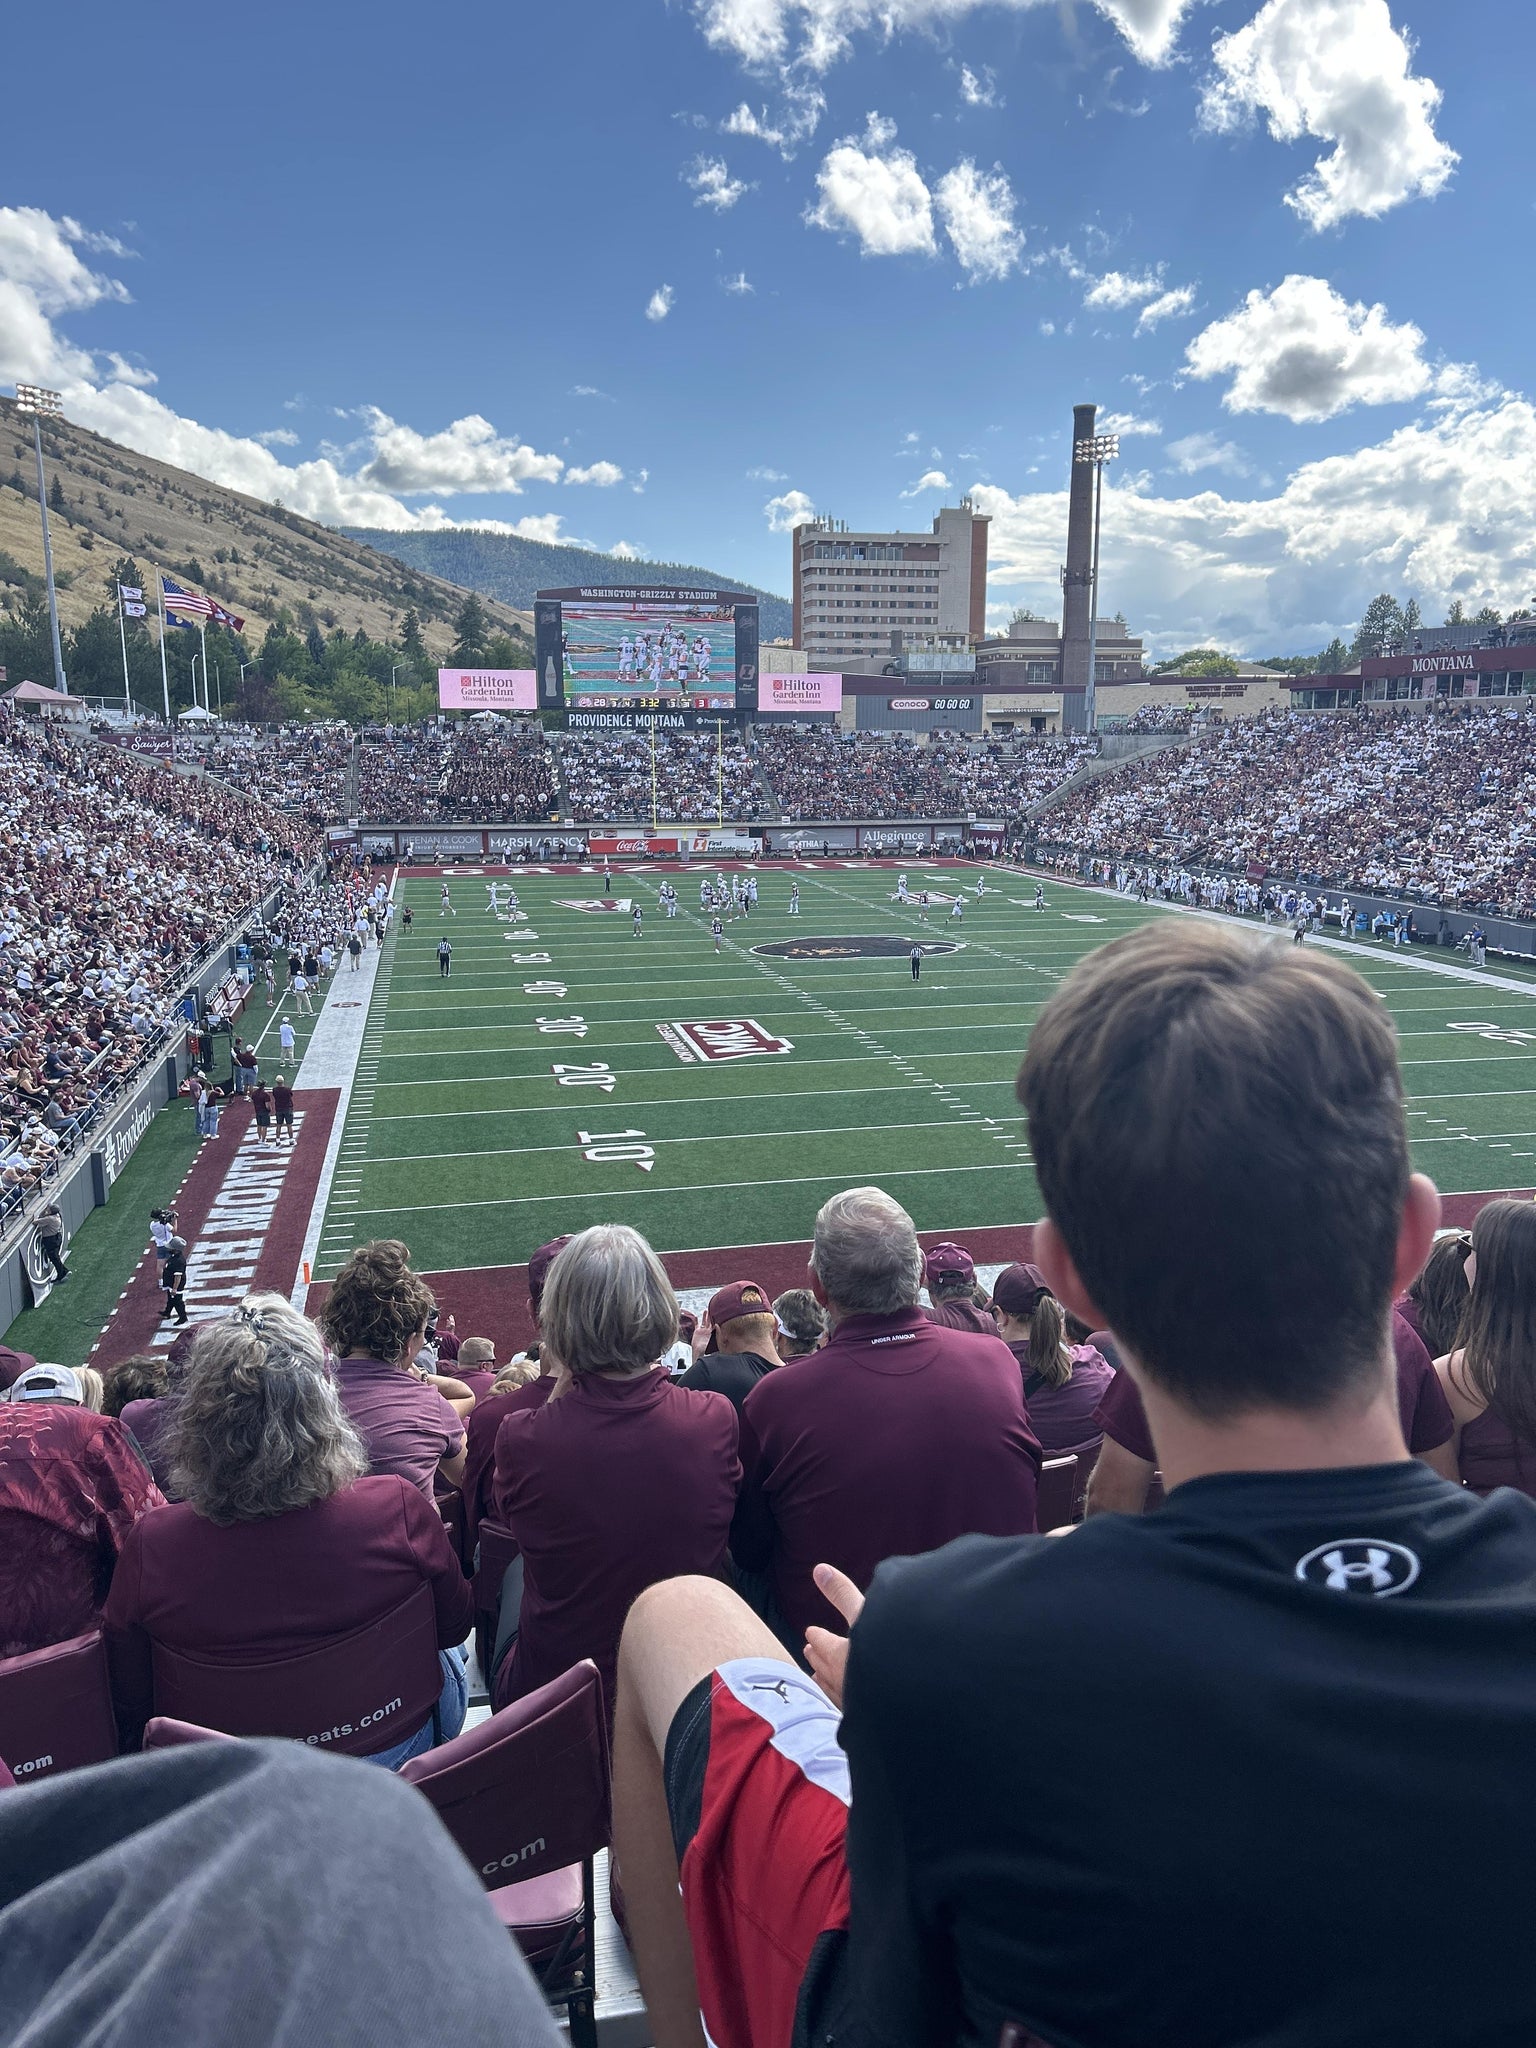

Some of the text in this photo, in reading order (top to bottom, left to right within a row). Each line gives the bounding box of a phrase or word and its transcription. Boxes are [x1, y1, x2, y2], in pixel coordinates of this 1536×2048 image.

[580, 588, 718, 600] WASHINGTON-GRIZZLY STADIUM
[1411, 655, 1475, 672] MONTANA
[472, 676, 513, 688] Hilton
[783, 680, 821, 691] Hilton
[461, 687, 514, 696] Garden Inn
[772, 690, 821, 699] Garden Inn
[593, 698, 606, 707] 28
[640, 698, 660, 708] 3:32
[934, 699, 946, 709] GO
[947, 699, 958, 709] GO
[568, 713, 686, 728] PROVIDENCE MONTANA
[131, 736, 172, 752] Sawyer
[401, 835, 440, 844] HEENAN
[451, 835, 479, 844] COOK
[490, 838, 533, 848] MARSH
[863, 830, 925, 844] Allegiance
[535, 1015, 589, 1033] 30
[692, 1022, 768, 1054] MKC
[551, 1062, 617, 1086] 20
[577, 1129, 656, 1162] 10
[871, 1333, 916, 1345] UNDER ARMOUR
[13, 1755, 53, 1776] com
[481, 1837, 546, 1875] com
